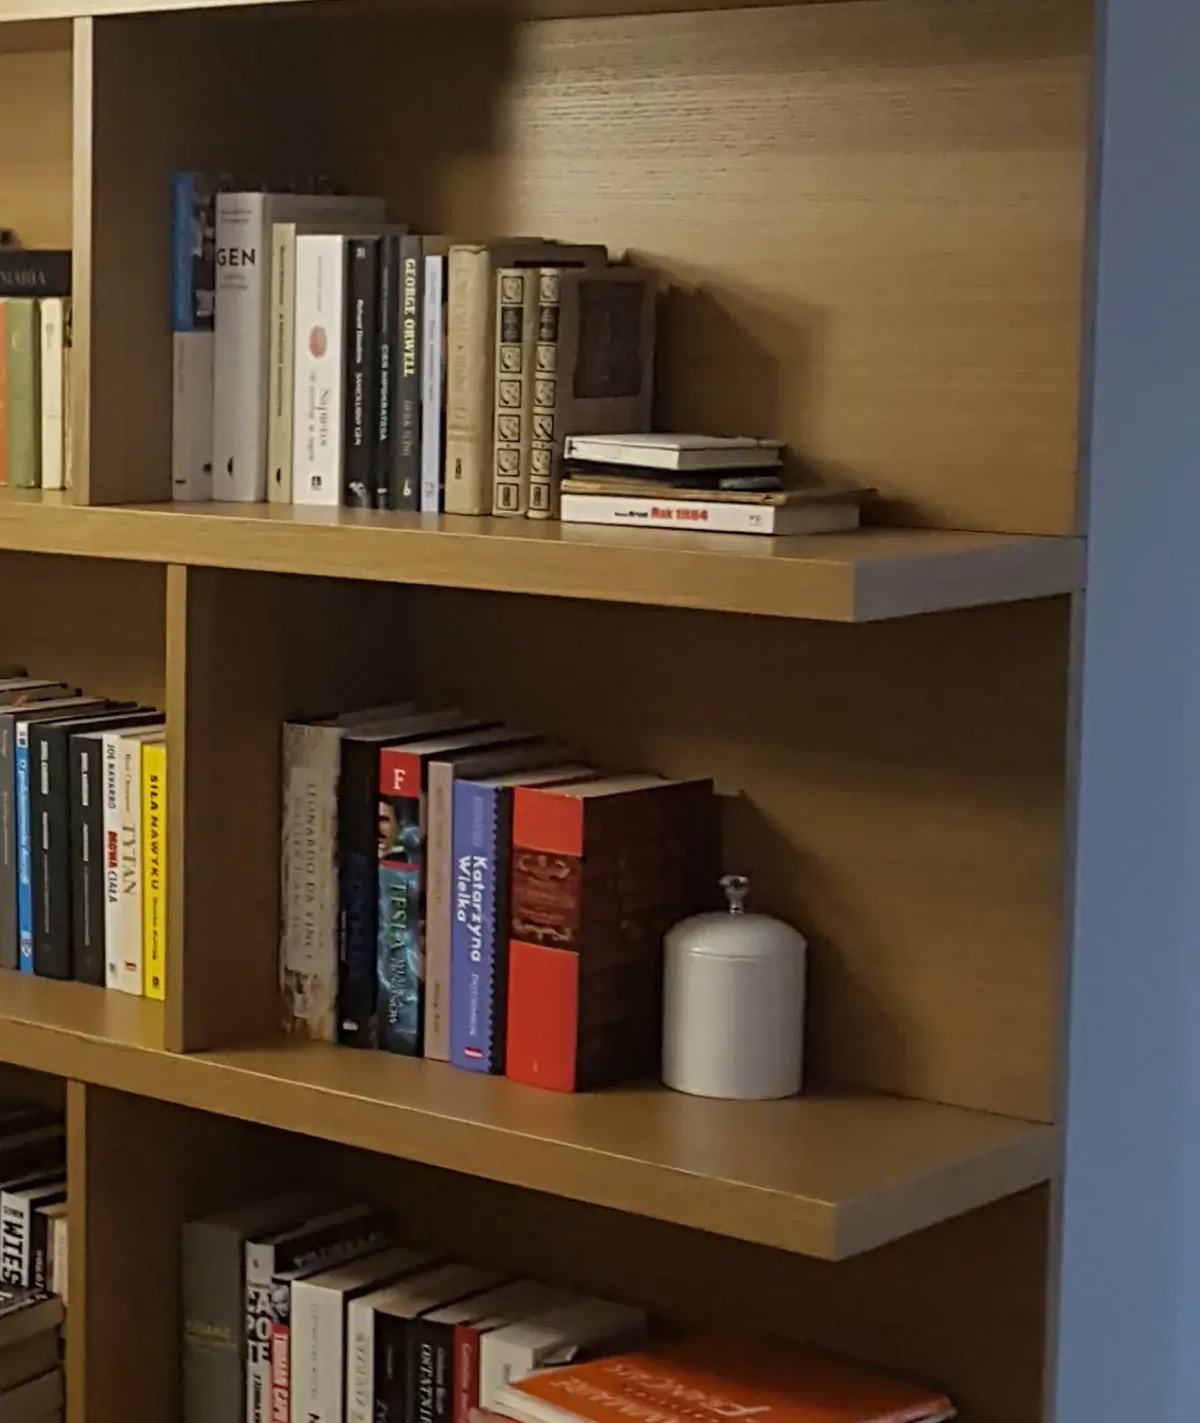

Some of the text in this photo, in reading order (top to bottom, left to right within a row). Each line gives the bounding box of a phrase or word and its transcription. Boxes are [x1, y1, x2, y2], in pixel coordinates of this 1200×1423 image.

[216, 247, 257, 267] GEN
[403, 258, 416, 376] GEORGE ORWELL
[107, 744, 117, 809] JOE NAVARRO
[121, 823, 136, 895] TYTAN
[149, 774, 160, 890] SIŁA NAWYKU
[107, 871, 118, 903] CIAŁA
[304, 783, 317, 960] LEONARDO DA VINCI
[456, 855, 472, 921] Wielka
[390, 881, 407, 949] TESLA
[466, 855, 487, 962] Katarzyna
